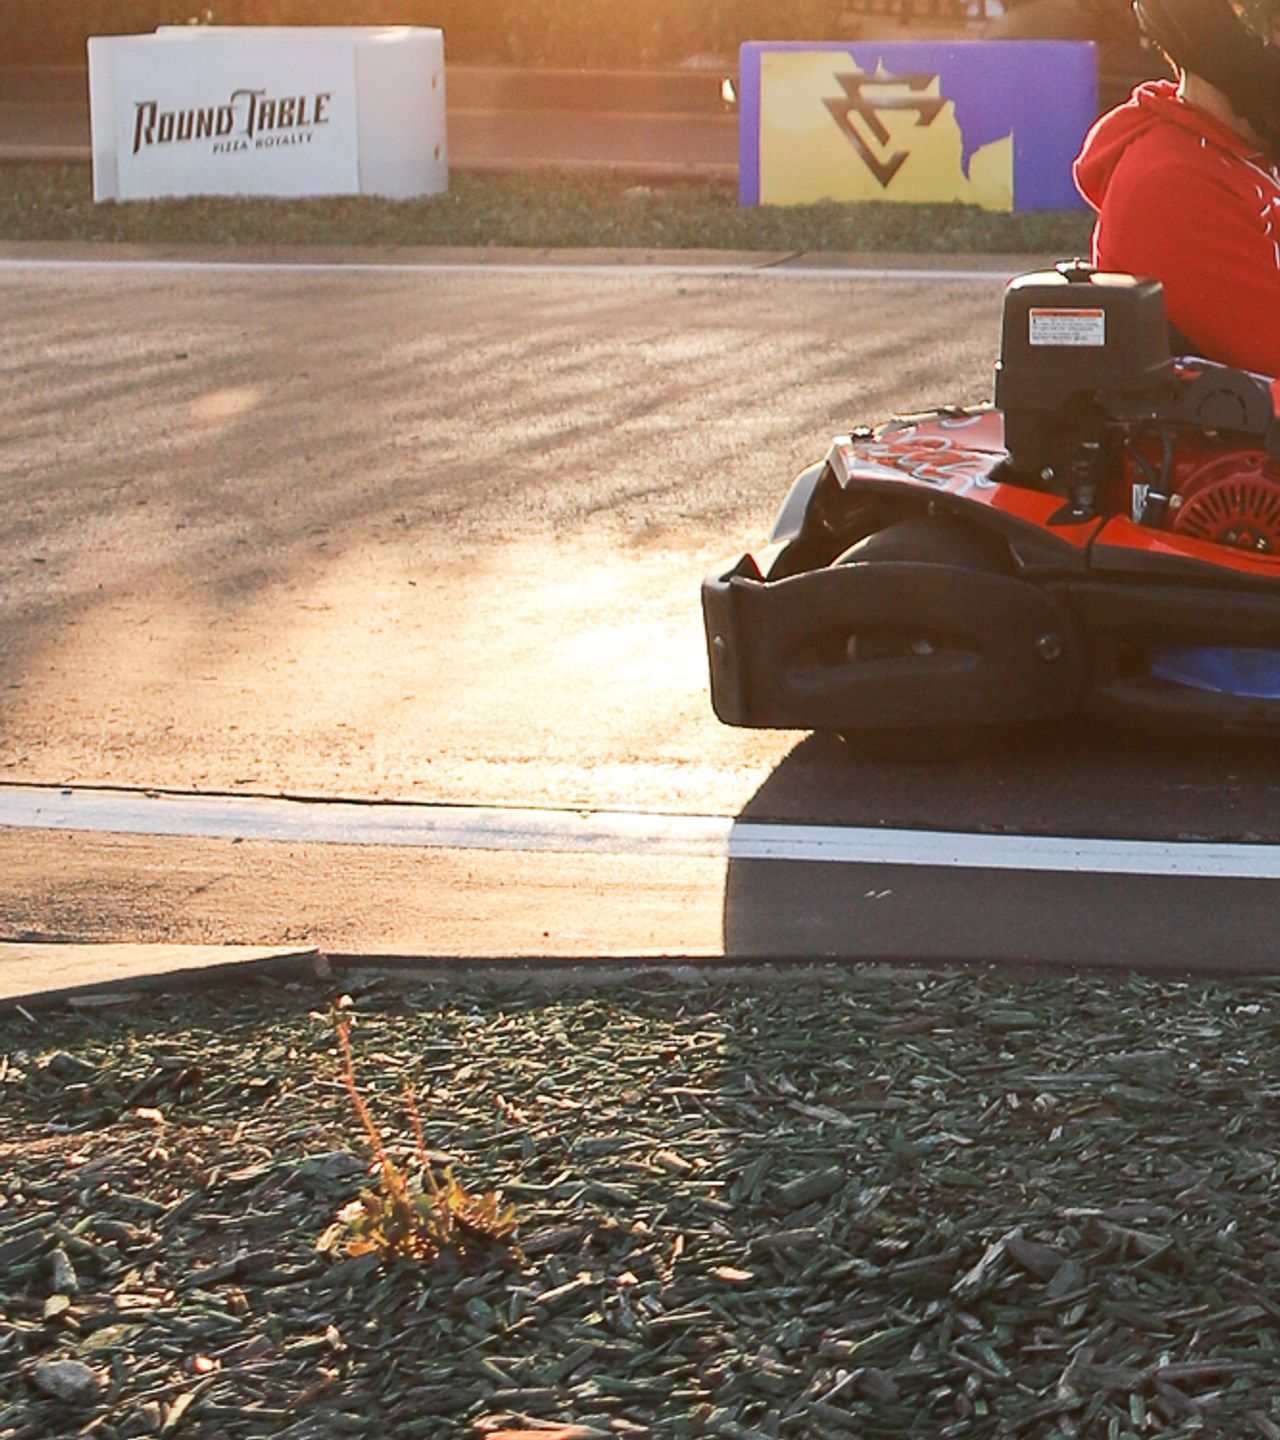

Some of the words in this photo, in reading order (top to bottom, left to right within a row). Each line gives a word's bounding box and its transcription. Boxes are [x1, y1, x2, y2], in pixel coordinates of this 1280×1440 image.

[133, 100, 235, 155] ROUND
[230, 88, 332, 139] TABLE
[212, 142, 249, 155] PIZZA
